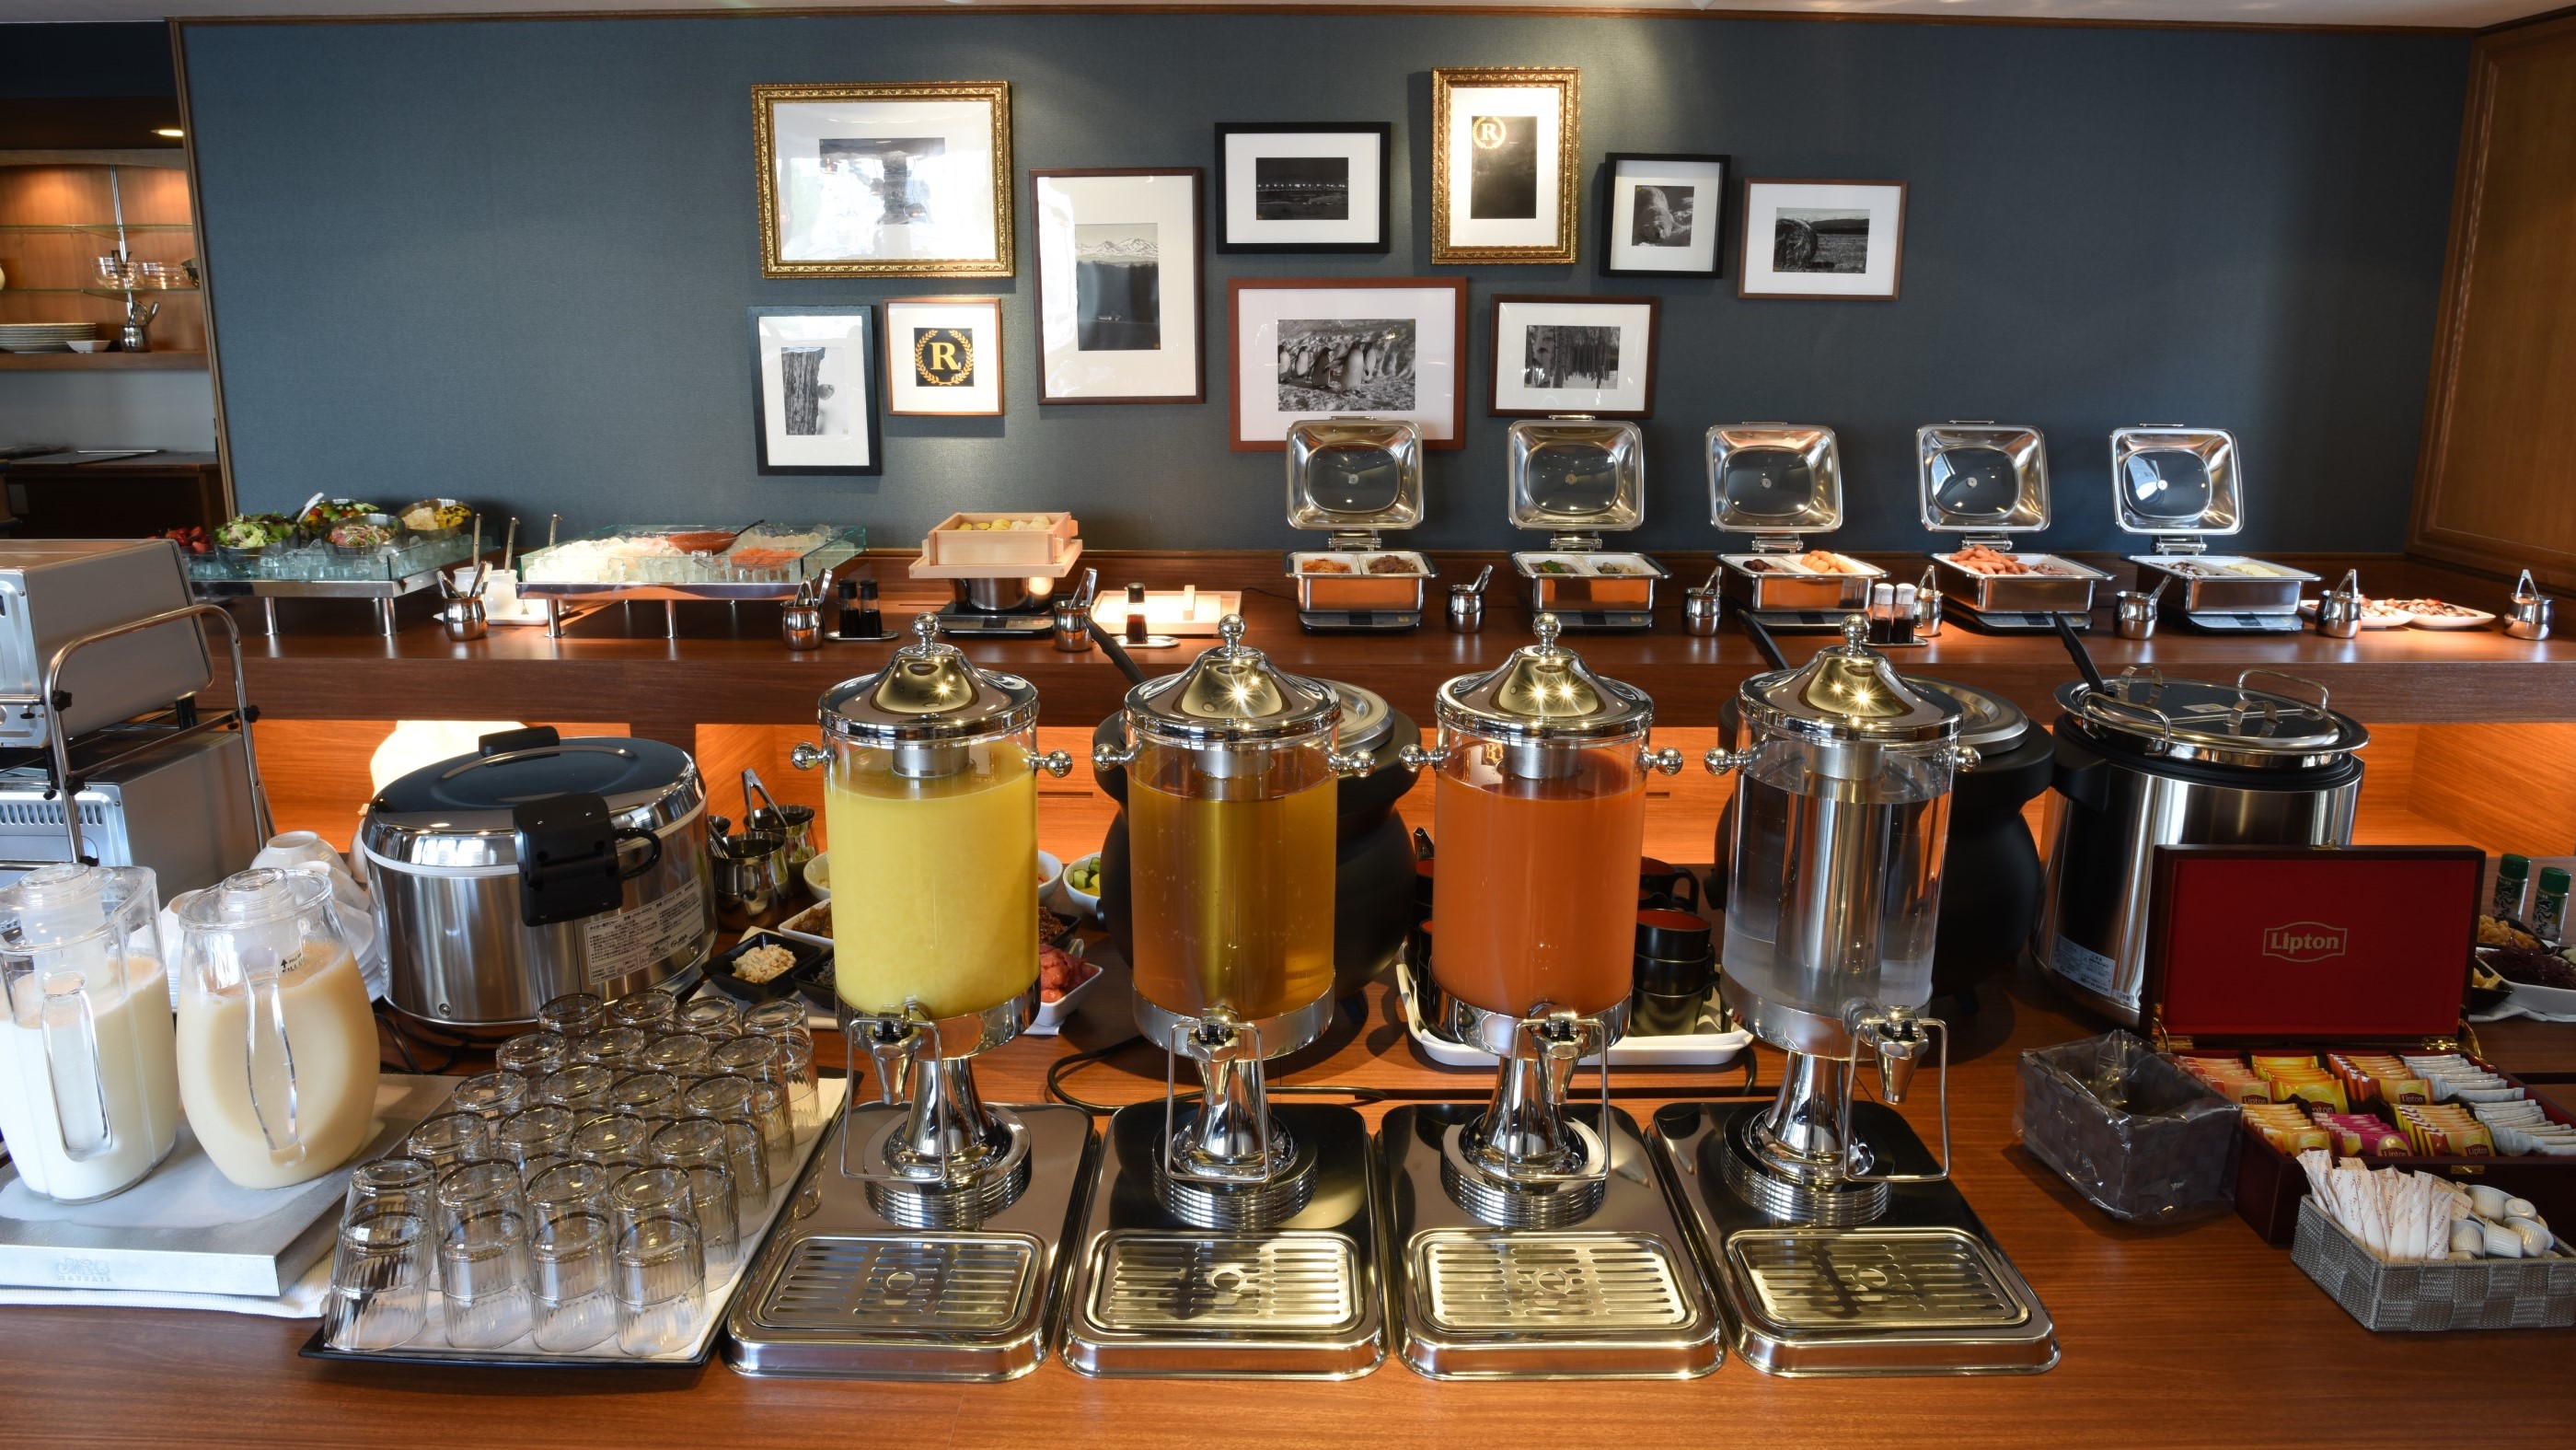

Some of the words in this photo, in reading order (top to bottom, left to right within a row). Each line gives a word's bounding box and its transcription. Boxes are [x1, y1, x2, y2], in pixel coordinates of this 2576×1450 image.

[1481, 122, 1499, 141] R
[929, 342, 961, 370] R
[2270, 932, 2339, 955] Lipton
[2244, 1096, 2268, 1105] Lipton
[2402, 1095, 2424, 1104] Lipton
[2434, 1214, 2447, 1232] SUGAR
